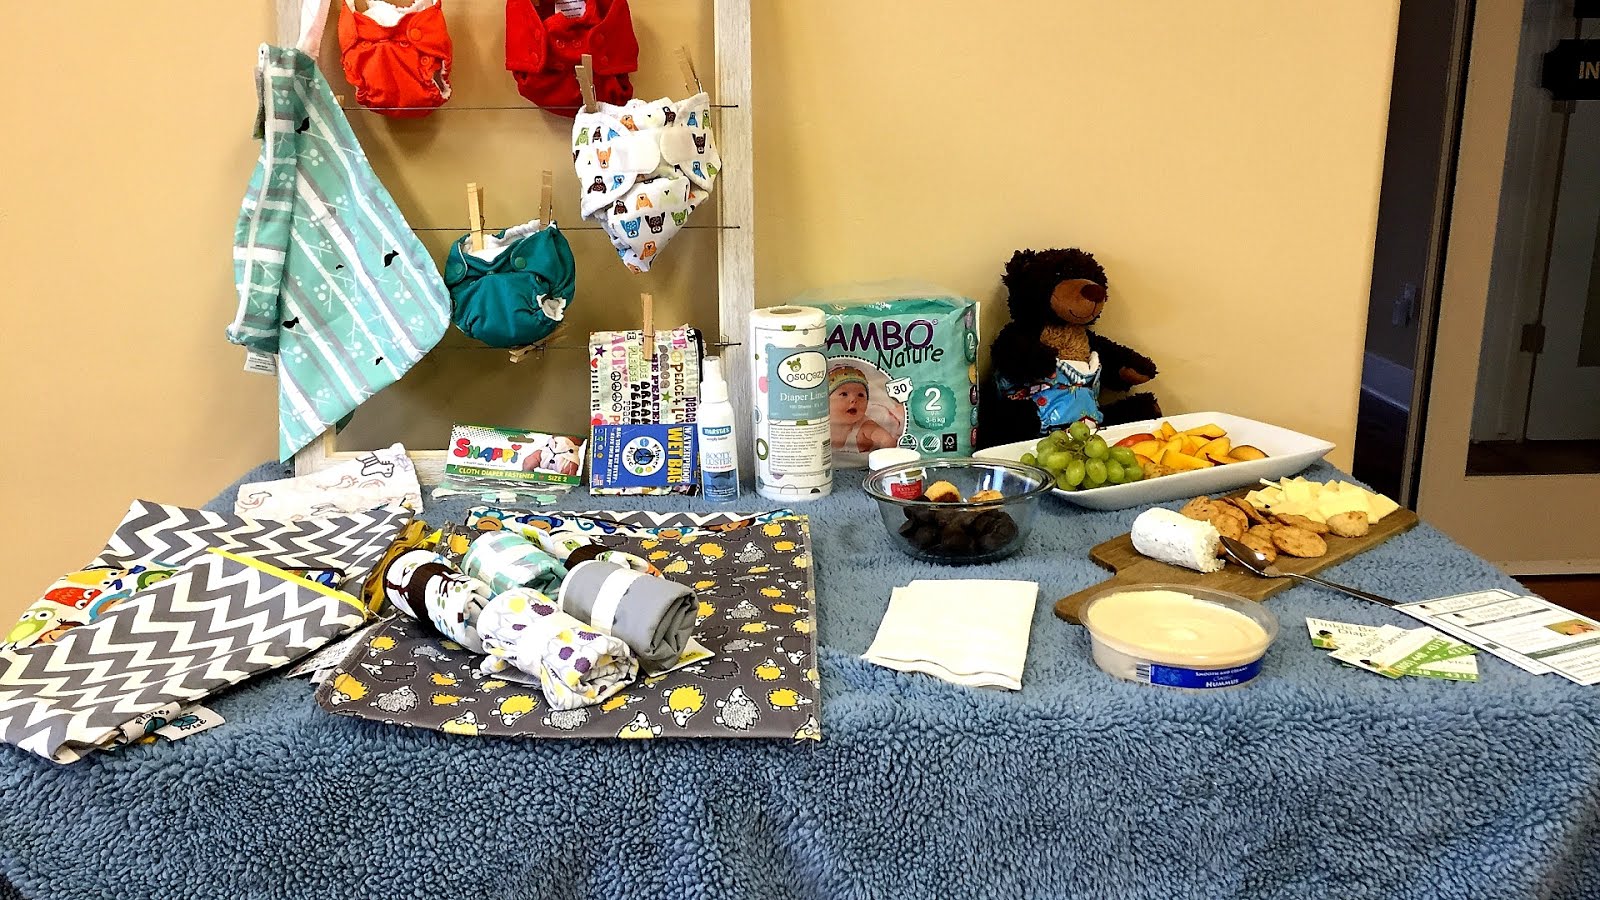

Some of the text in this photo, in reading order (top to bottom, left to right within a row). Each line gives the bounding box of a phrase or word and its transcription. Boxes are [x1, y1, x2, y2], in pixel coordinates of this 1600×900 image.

[826, 319, 934, 352] AMBO
[628, 346, 639, 382] PLEASE
[877, 343, 945, 371] Nature
[671, 363, 684, 396] PEACE
[893, 383, 908, 395] 30
[631, 384, 641, 425] PEACE
[682, 397, 697, 423] peace
[780, 391, 809, 404] Diaper
[924, 387, 942, 412] 2
[652, 444, 661, 469] Planet
[667, 427, 683, 484] WET BAG
[681, 427, 692, 484] WATERPROOF
[458, 467, 480, 476] CLOTH
[481, 470, 504, 478] DIAPER
[504, 471, 535, 480] FASTENER
[134, 709, 171, 726] Planet
